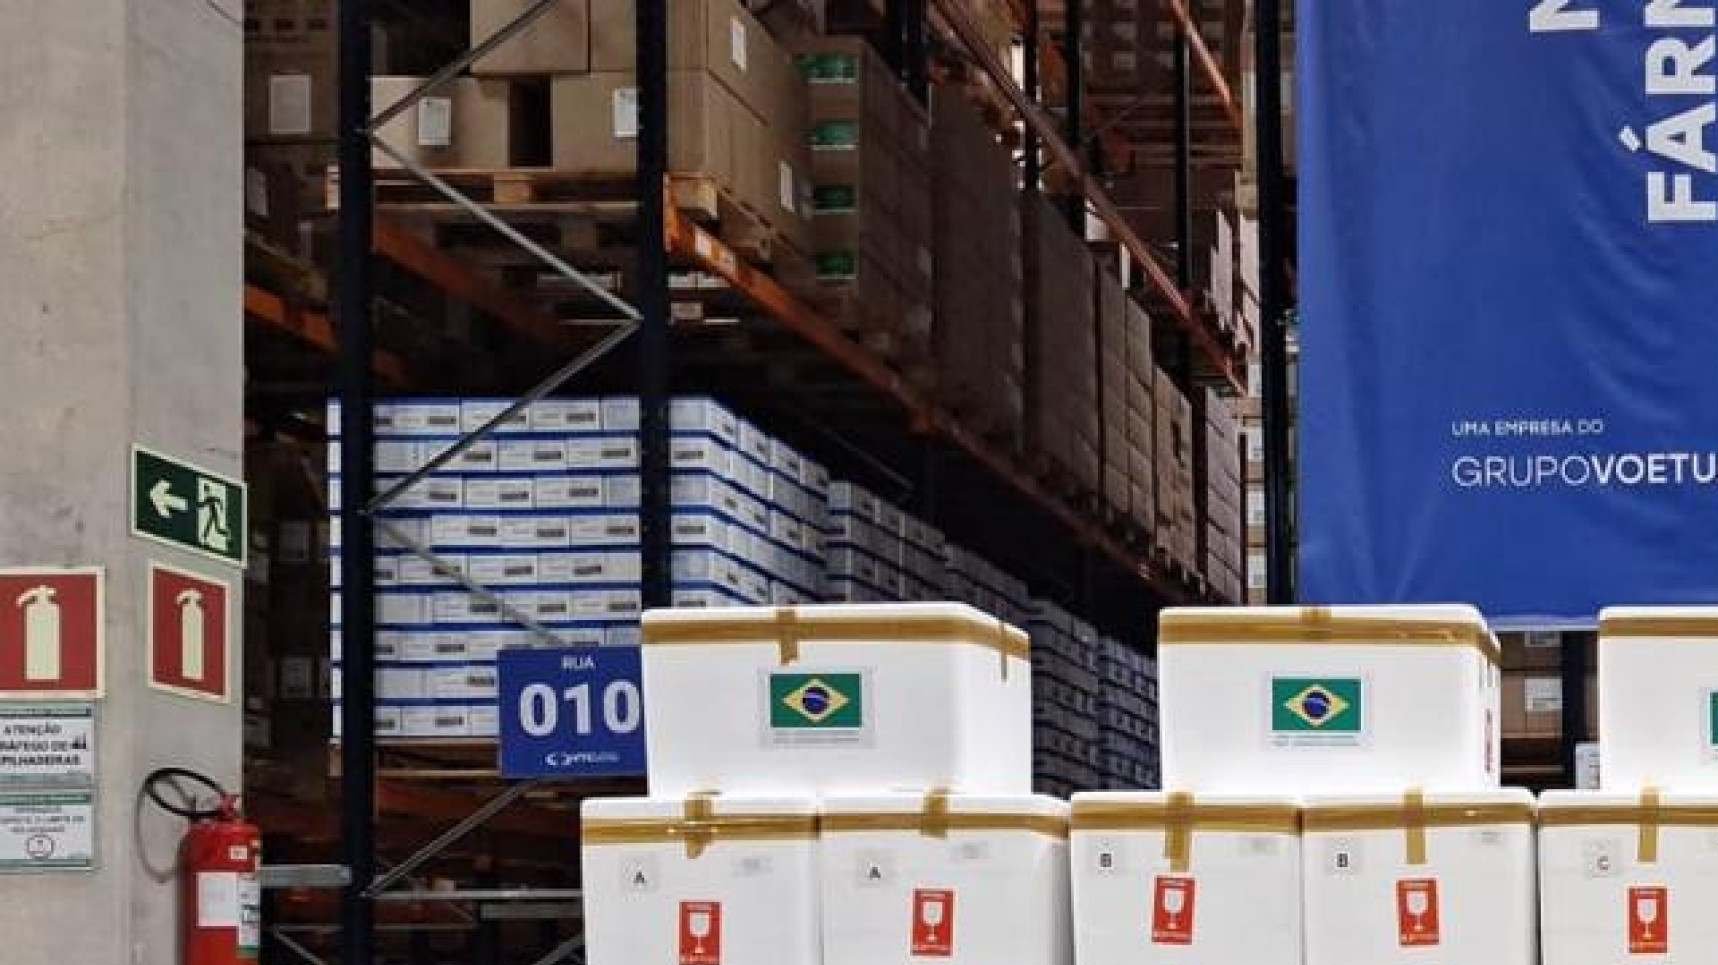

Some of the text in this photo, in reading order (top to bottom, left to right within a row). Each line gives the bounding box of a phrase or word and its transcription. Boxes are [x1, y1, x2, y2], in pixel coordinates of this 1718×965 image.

[1450, 418, 1604, 436] UMA EMPRESA DO
[560, 655, 595, 670] RUA
[519, 680, 641, 737] 010
